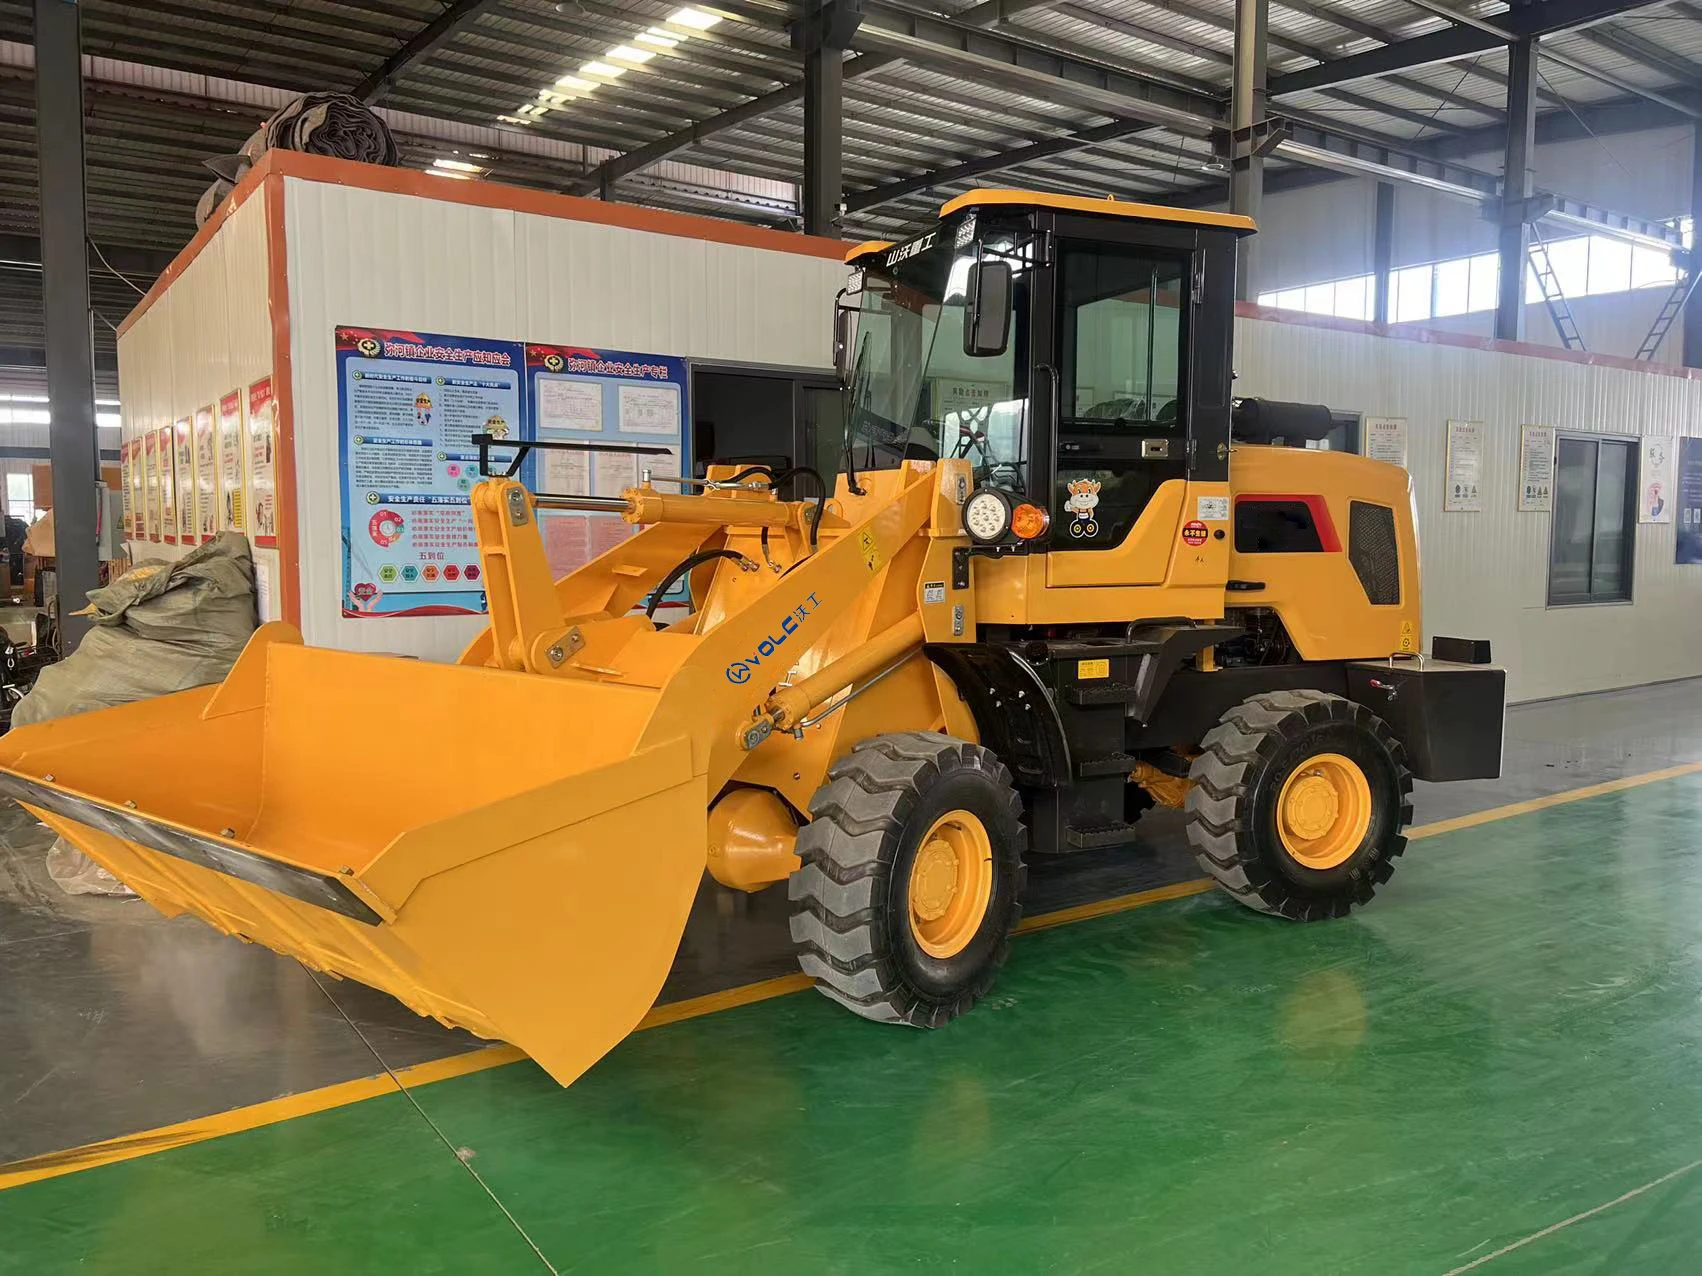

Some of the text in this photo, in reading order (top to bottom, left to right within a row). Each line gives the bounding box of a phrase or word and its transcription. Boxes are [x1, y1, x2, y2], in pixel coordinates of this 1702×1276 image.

[886, 232, 937, 267] 山沃重工
[384, 342, 511, 367] 弥河镇企业安全生产应知应会
[568, 357, 668, 379] 弥河镇企业安全生产专栏
